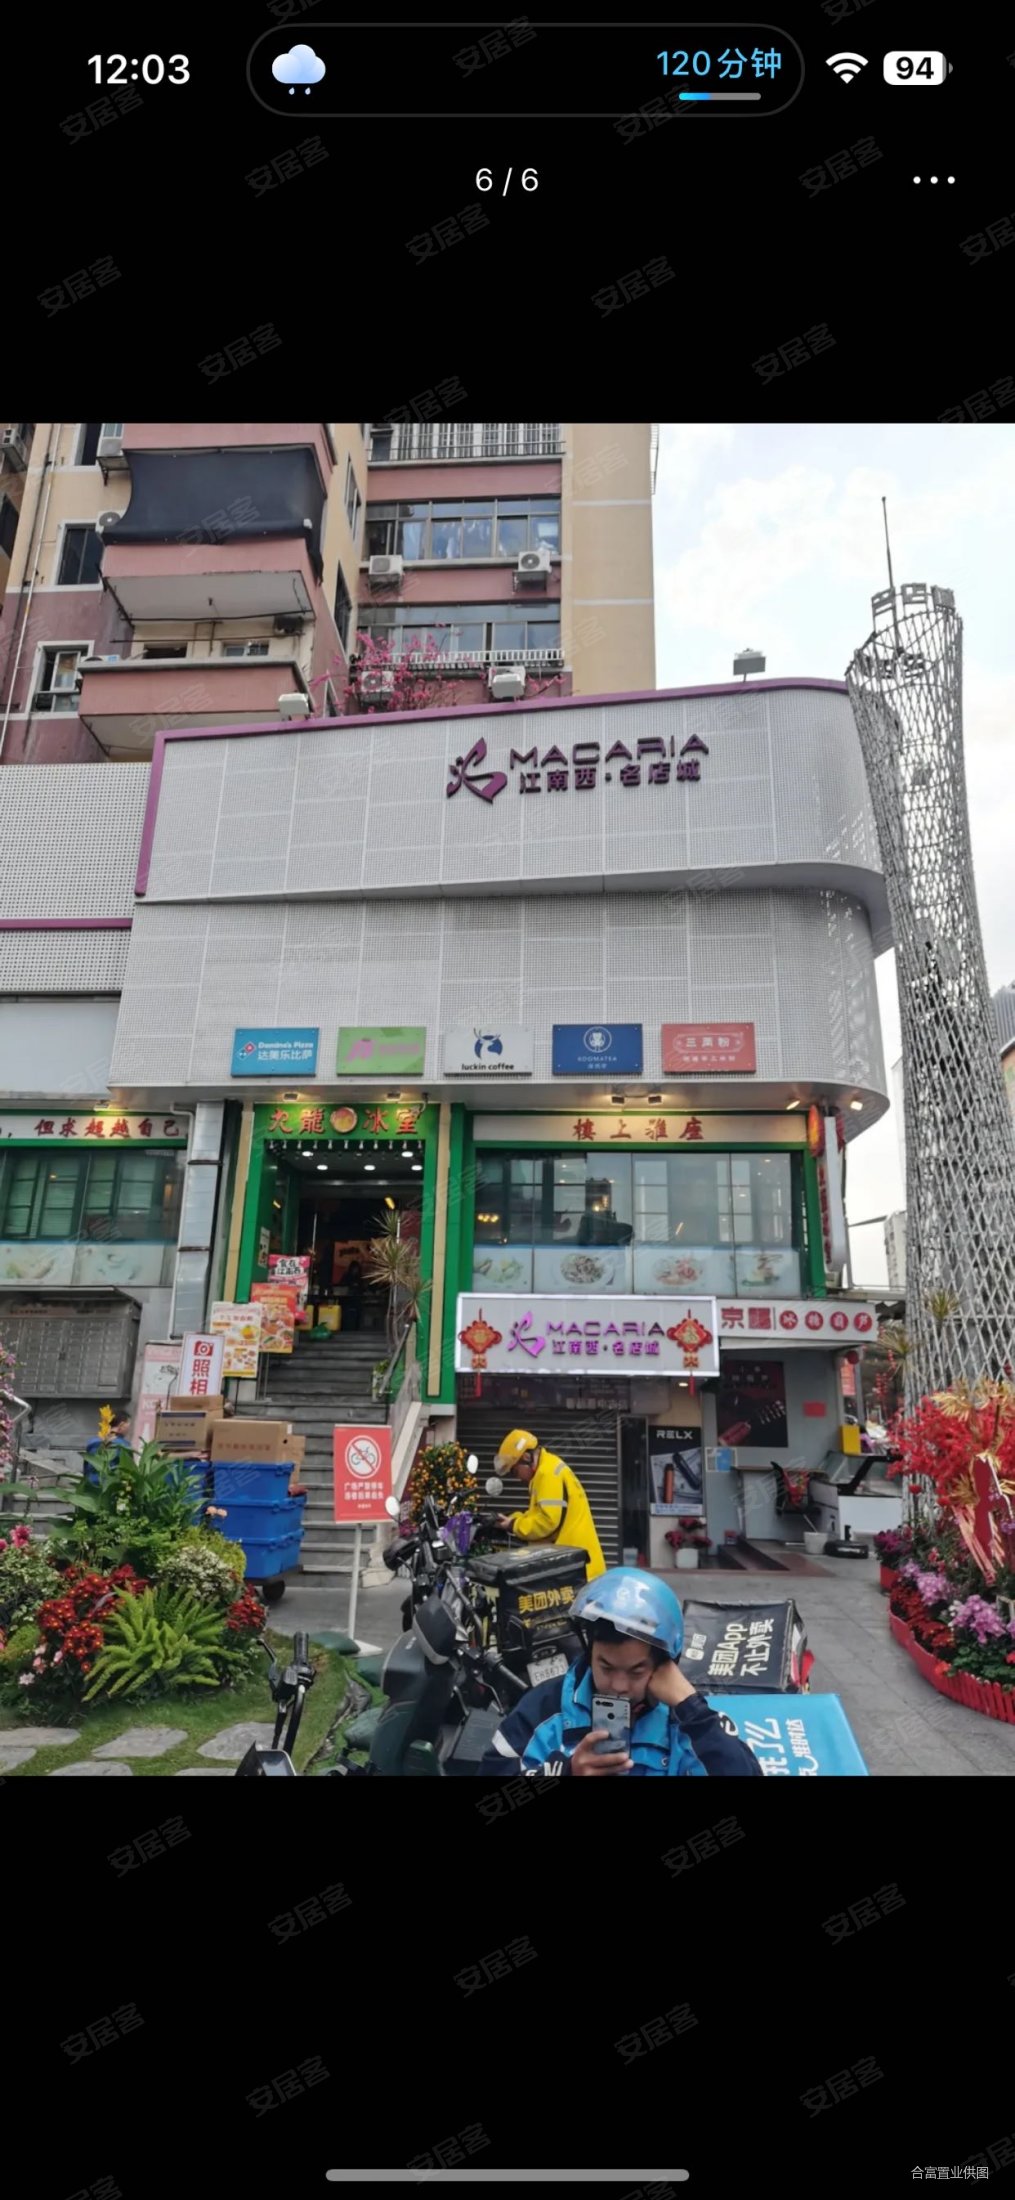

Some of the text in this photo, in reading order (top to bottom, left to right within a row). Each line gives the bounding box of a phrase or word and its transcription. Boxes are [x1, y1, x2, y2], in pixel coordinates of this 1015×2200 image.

[509, 733, 709, 770] MACARIA
[519, 758, 701, 795] 江南西·名店城
[257, 1049, 313, 1061] 达美乐比萨
[461, 1062, 514, 1071] luckin coffee
[546, 1321, 666, 1338] MACARIA
[656, 1429, 694, 1440] RELX
[518, 1585, 575, 1615] 美团外卖
[707, 1623, 748, 1677] 美团App
[740, 1618, 774, 1676] 不止外卖
